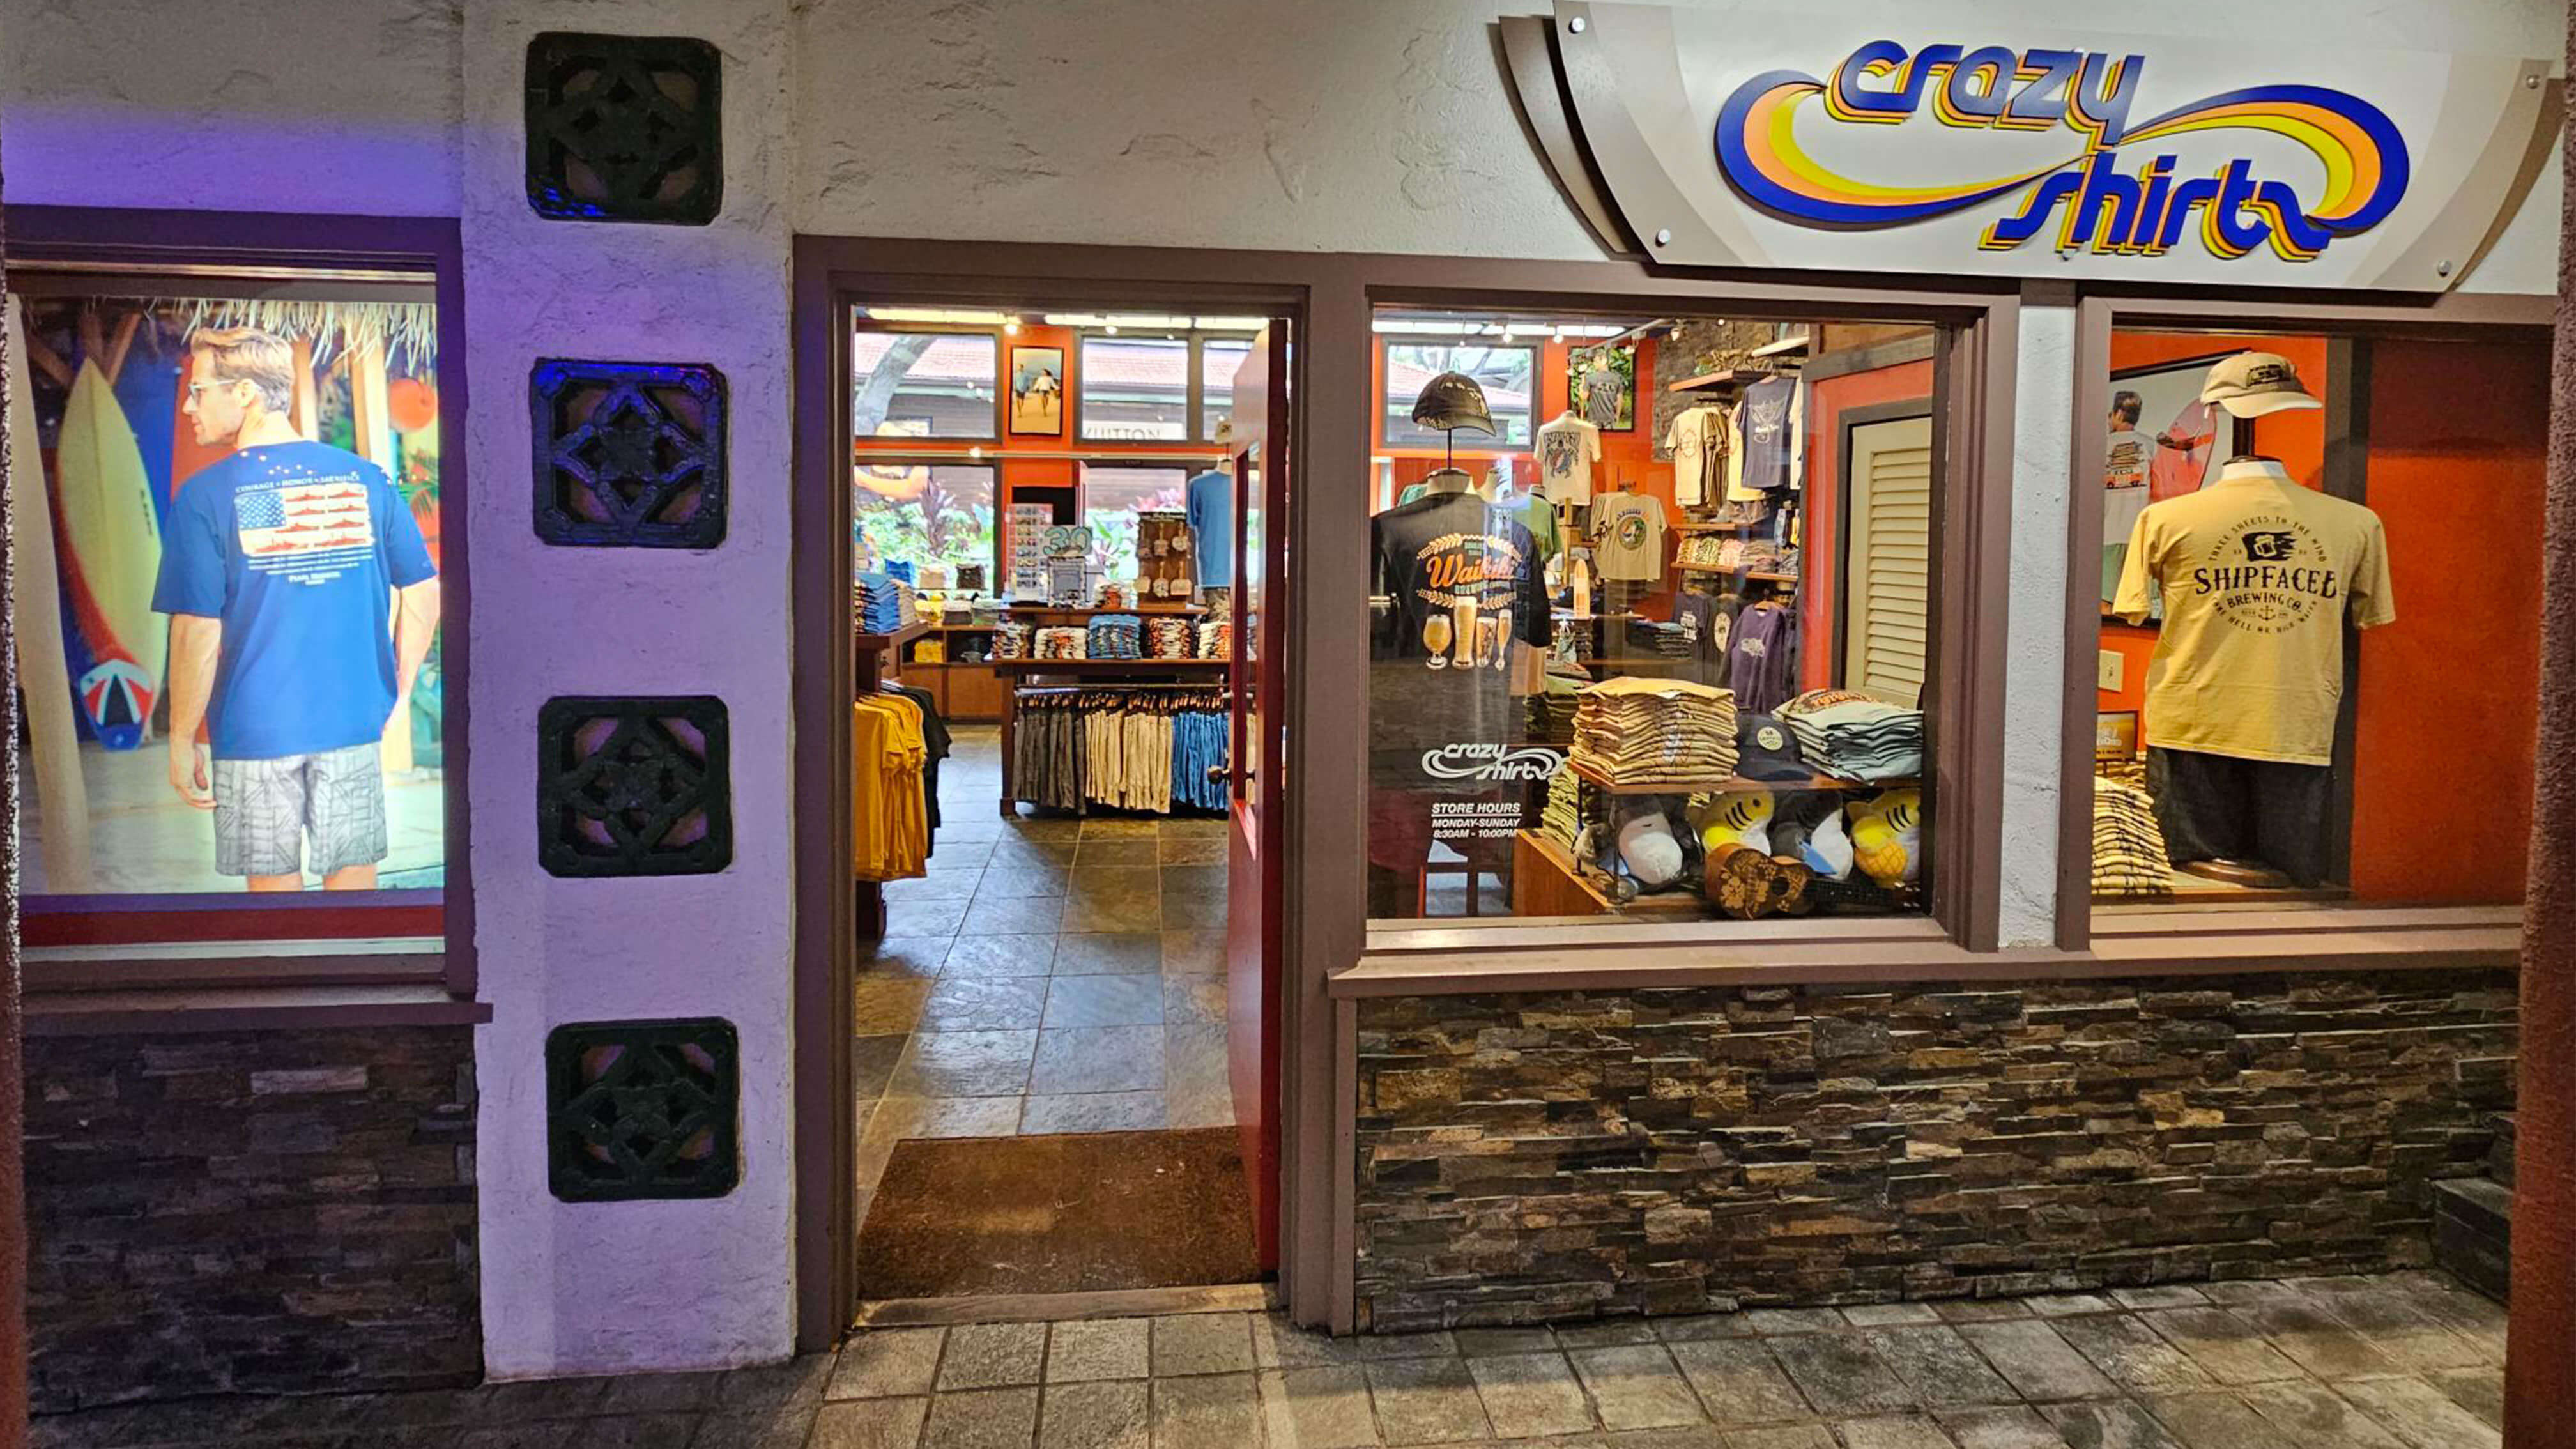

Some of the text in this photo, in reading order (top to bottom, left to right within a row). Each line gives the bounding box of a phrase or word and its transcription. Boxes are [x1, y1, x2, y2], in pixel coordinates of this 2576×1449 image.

[1827, 40, 2145, 148] crazy
[2231, 516, 2269, 533] SHEETS
[2194, 566, 2338, 599] SHIPFACED
[2227, 592, 2285, 608] BREWING
[1443, 743, 1508, 760] crazy
[1432, 802, 1521, 813] STORE HOURS
[1432, 818, 1520, 828] MONDAY-SUNDAY
[1433, 829, 1469, 838] 8:30AM
[1478, 829, 1517, 838] 10:00PM
